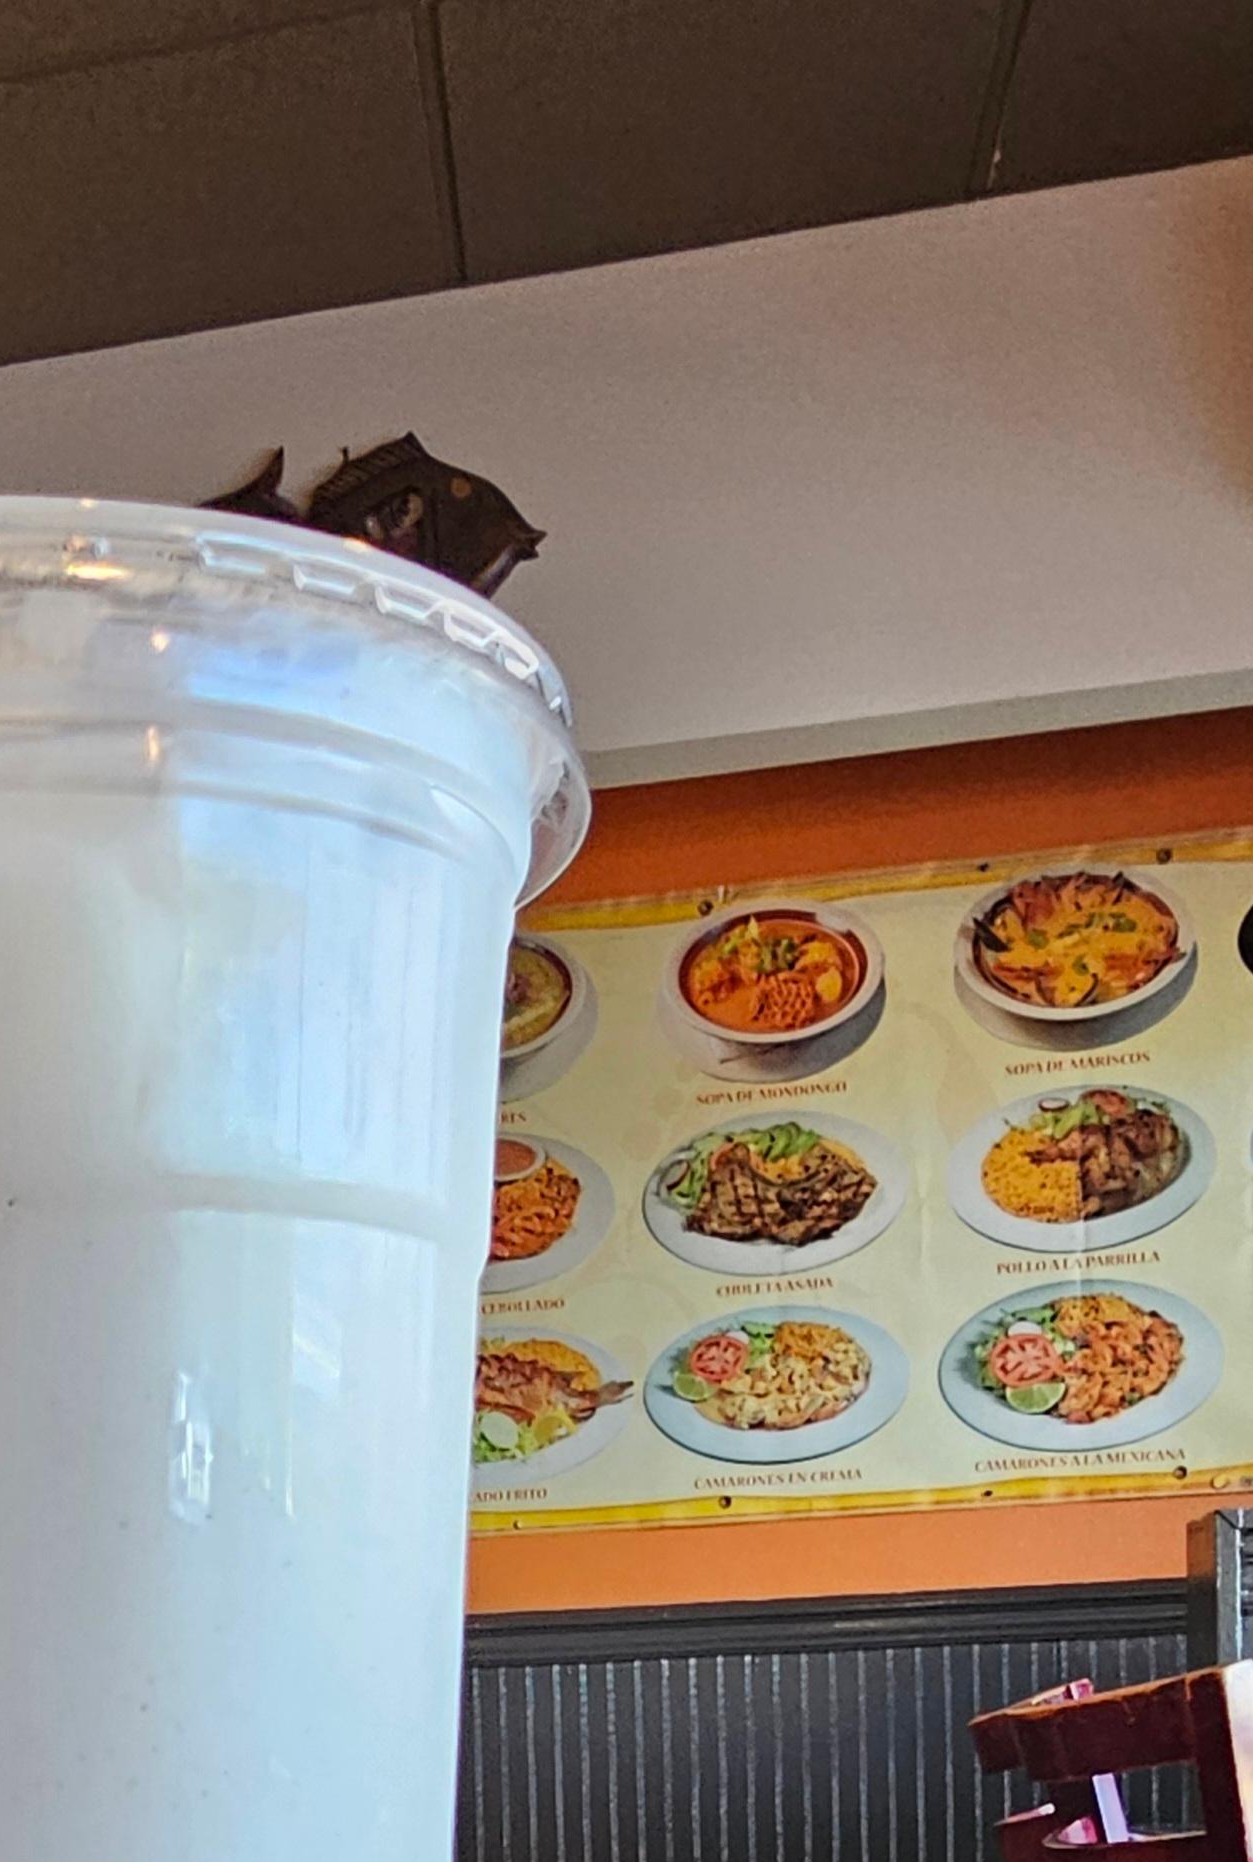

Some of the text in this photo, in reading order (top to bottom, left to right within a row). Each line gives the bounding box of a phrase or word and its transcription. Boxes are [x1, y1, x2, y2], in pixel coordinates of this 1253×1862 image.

[1005, 1051, 1151, 1075] SOPA DE MARISCOS
[696, 1081, 848, 1105] SOPA DE MONDONGO
[996, 1251, 1160, 1275] POLLO A LA PARRILLA
[786, 1277, 834, 1292] ASADA
[974, 1448, 1186, 1473] CAMARONES A LA MEXICANA
[694, 1469, 862, 1489] CAMARONES EN CREMA
